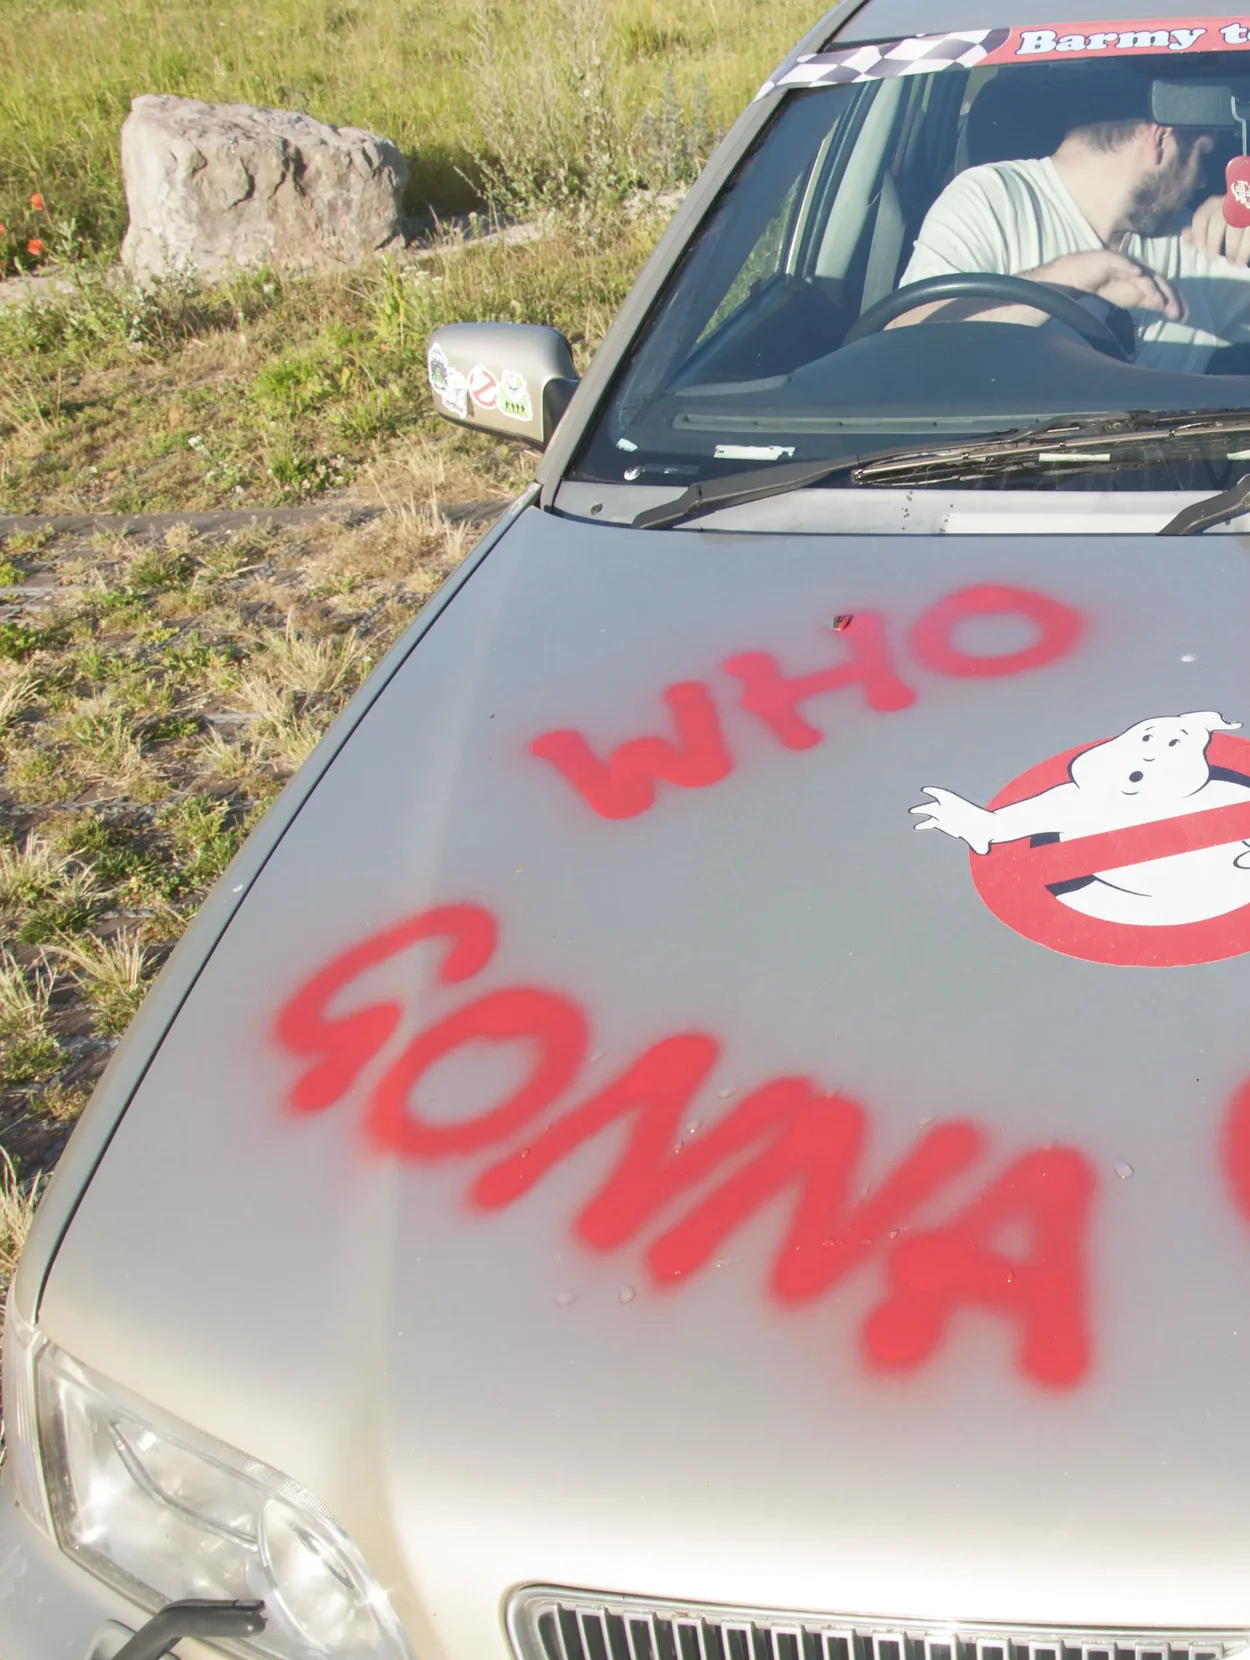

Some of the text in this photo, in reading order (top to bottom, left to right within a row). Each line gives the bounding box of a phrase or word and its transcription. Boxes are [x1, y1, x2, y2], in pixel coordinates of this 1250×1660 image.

[1015, 28, 1207, 55] Barmy
[526, 580, 1088, 822] WHO
[272, 900, 1099, 1394] GONNA
